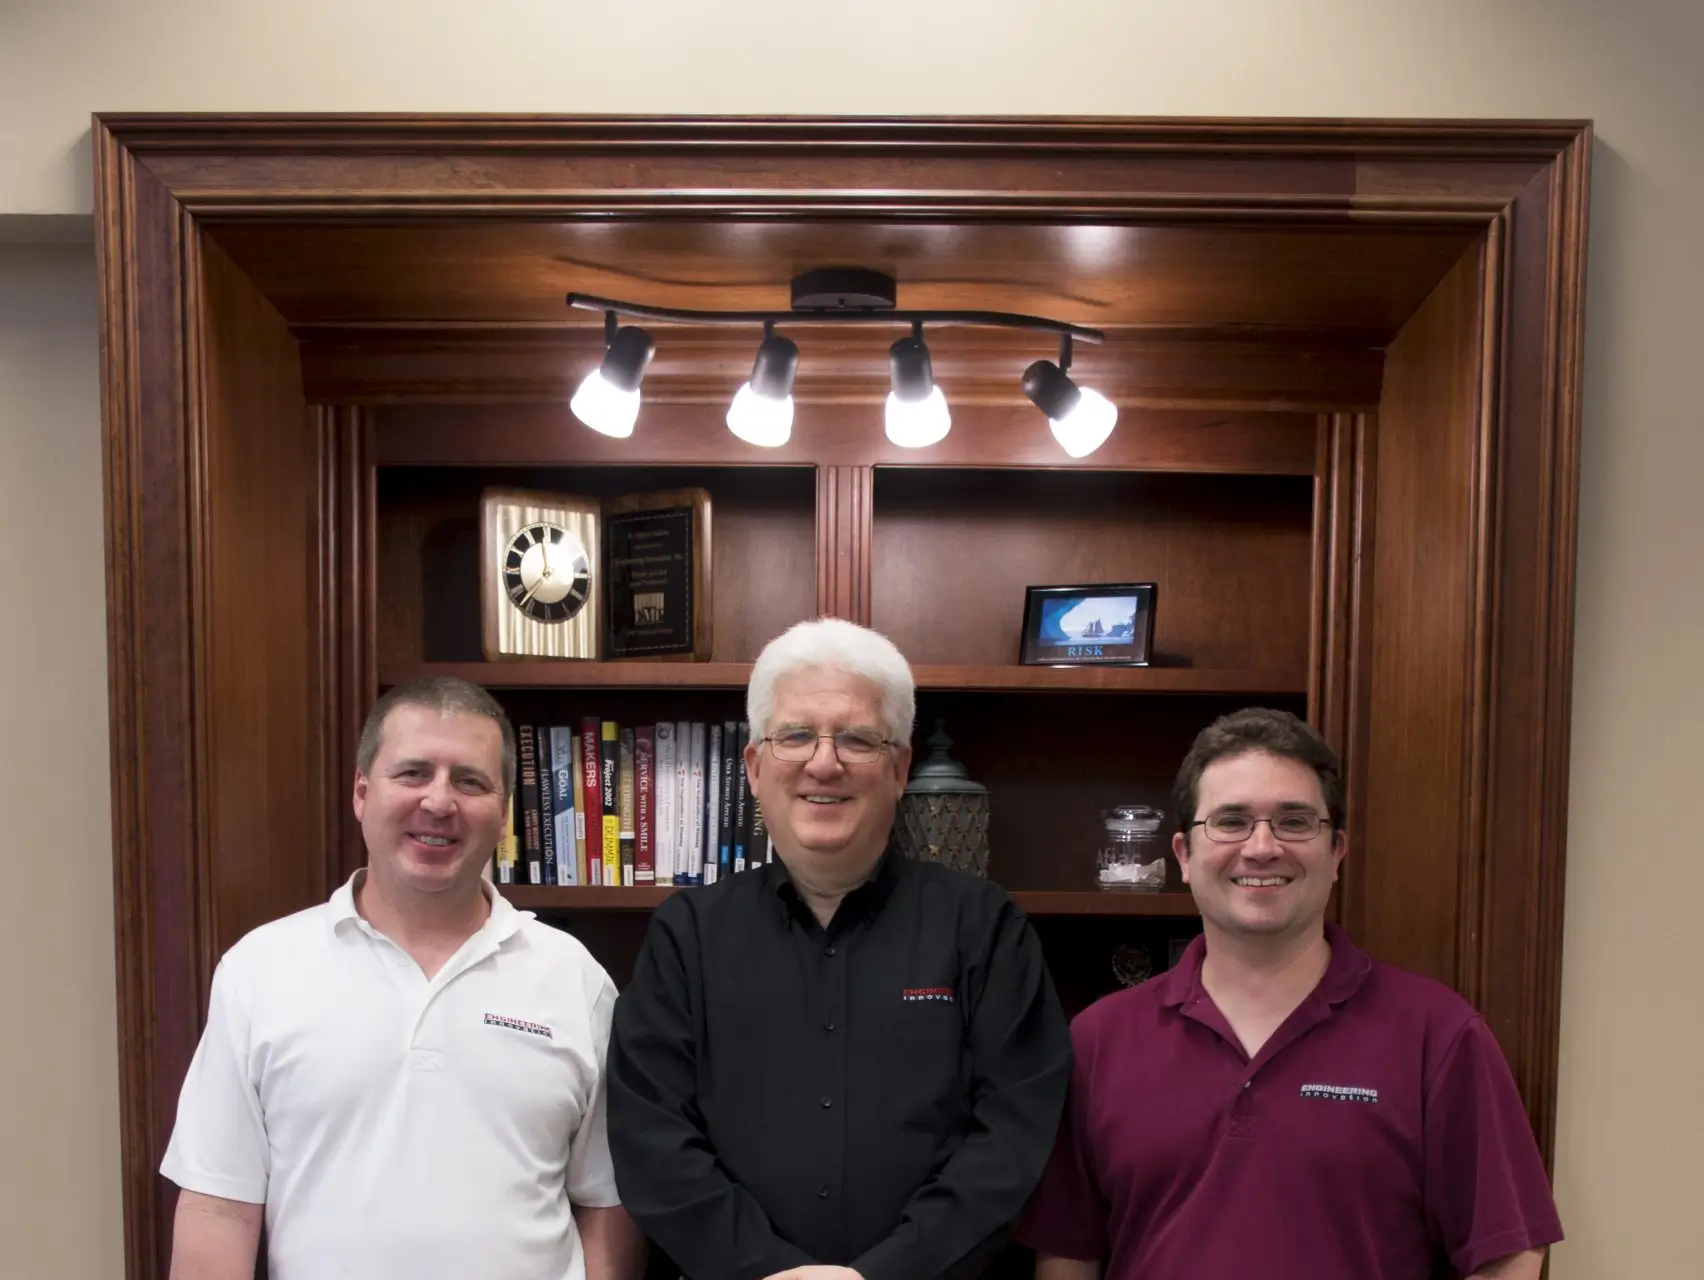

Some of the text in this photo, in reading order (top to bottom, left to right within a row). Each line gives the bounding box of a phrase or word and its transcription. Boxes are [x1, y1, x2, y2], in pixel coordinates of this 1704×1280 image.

[1068, 645, 1104, 657] RISK
[520, 725, 536, 786] EXECUTION
[584, 731, 597, 788] MAKERS
[640, 753, 648, 794] SERVICE
[540, 768, 551, 809] FLAWLESS
[558, 768, 568, 800] GOAL
[604, 759, 614, 807] Project 2002
[622, 784, 632, 830] STRENGTH
[640, 795, 648, 814] WITH
[753, 799, 764, 836] NING
[543, 813, 554, 865] EXECUTION
[604, 825, 615, 866] DUMMIE
[640, 821, 648, 852] SMILE
[1299, 1091, 1378, 1104] innovation
[1300, 1084, 1378, 1098] ENGINEERING
